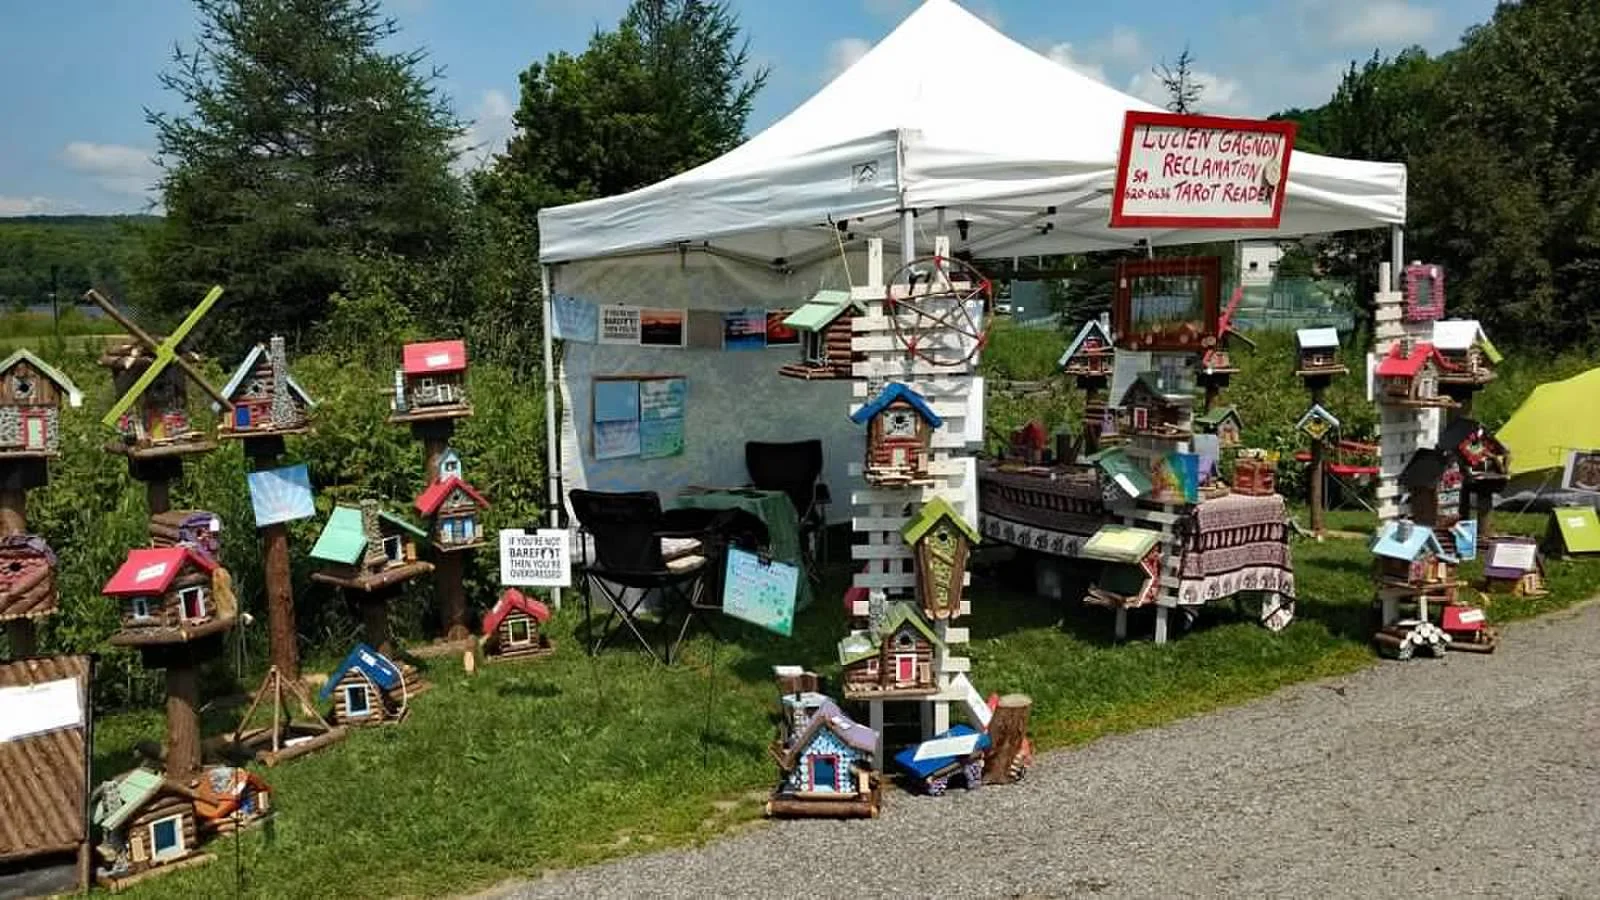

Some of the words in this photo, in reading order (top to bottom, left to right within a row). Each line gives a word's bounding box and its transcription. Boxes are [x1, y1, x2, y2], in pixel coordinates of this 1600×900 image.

[1143, 126, 1215, 150] LUCIEN
[1218, 129, 1283, 160] GAGNON
[1162, 153, 1262, 184] RECLAMATION
[1174, 180, 1222, 203] TAROT
[510, 559, 532, 569] THEN
